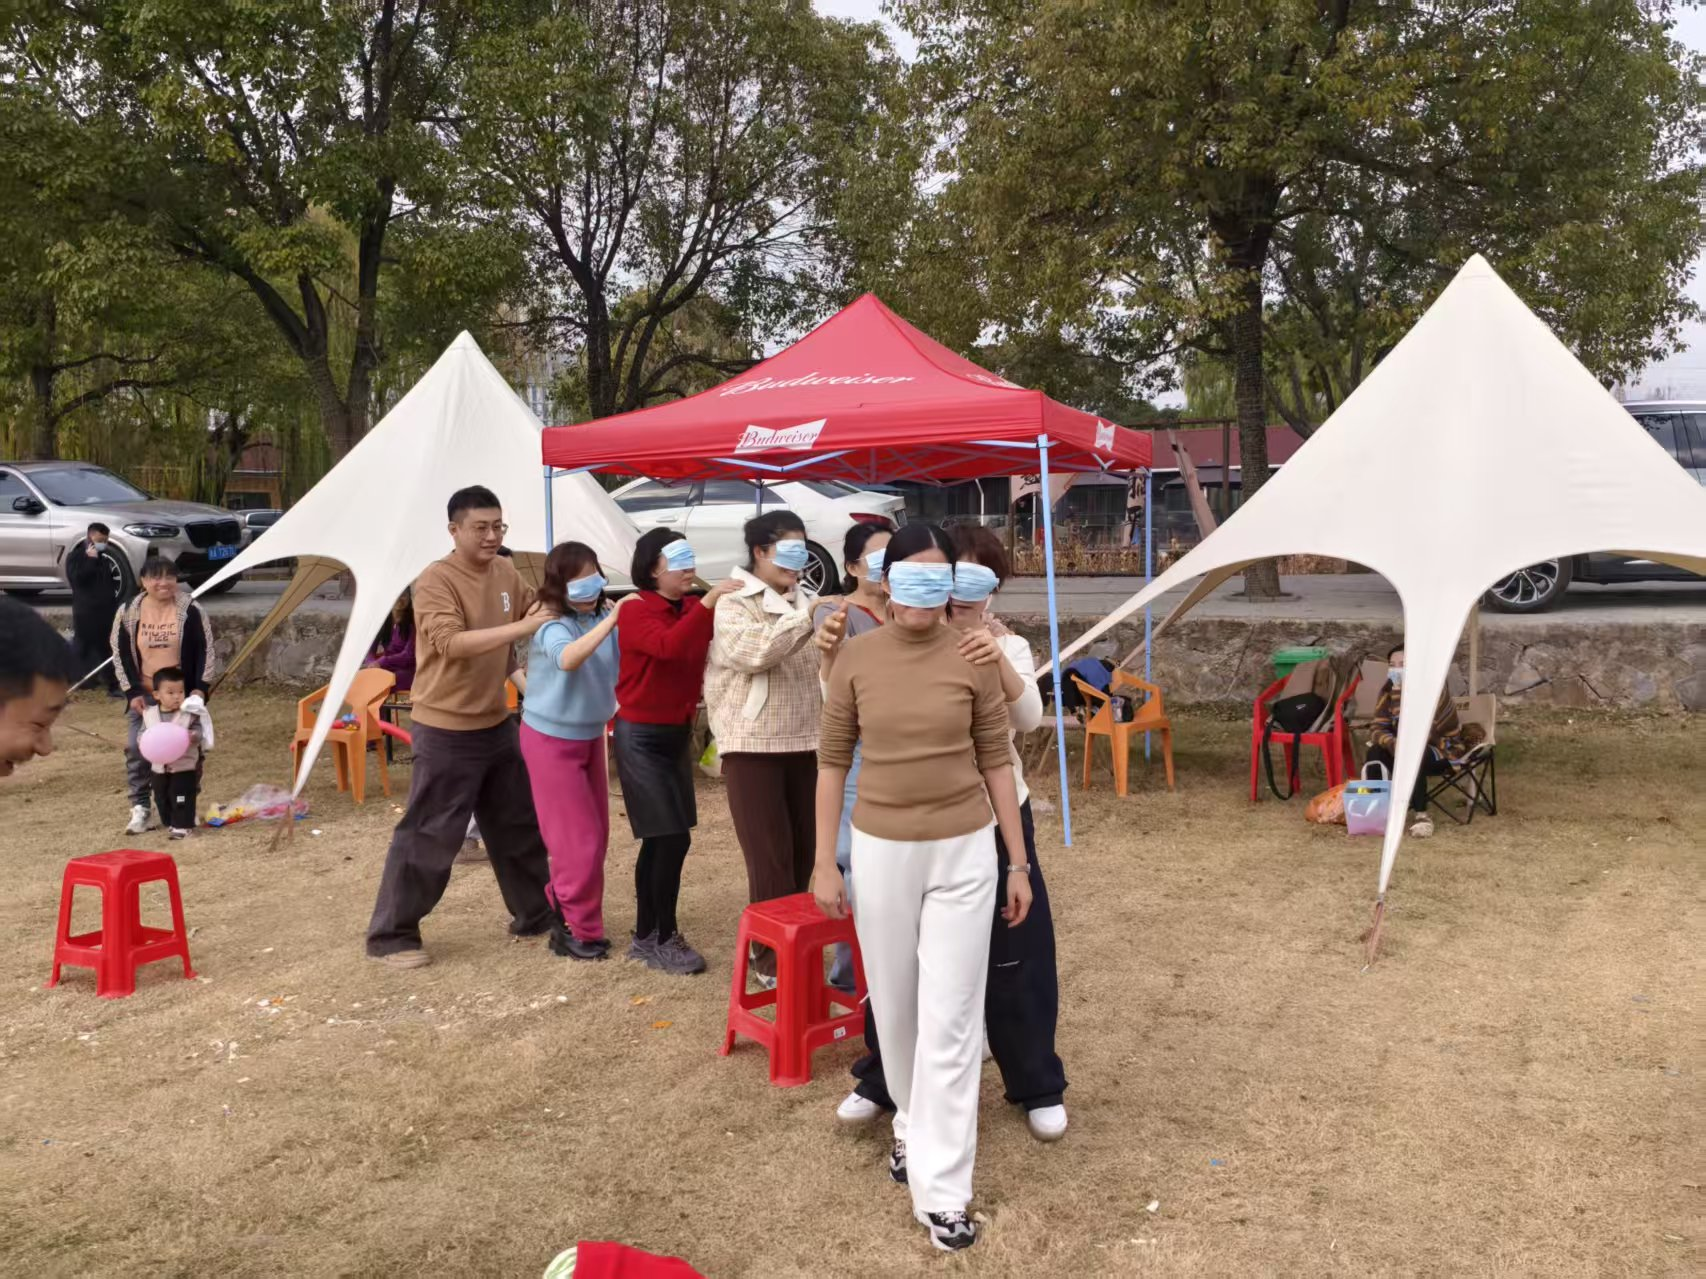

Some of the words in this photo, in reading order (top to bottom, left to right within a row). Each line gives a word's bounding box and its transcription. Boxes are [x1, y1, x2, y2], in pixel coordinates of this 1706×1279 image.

[720, 372, 916, 397] Budweiser
[738, 428, 819, 448] Budweiser
[501, 592, 511, 612] B
